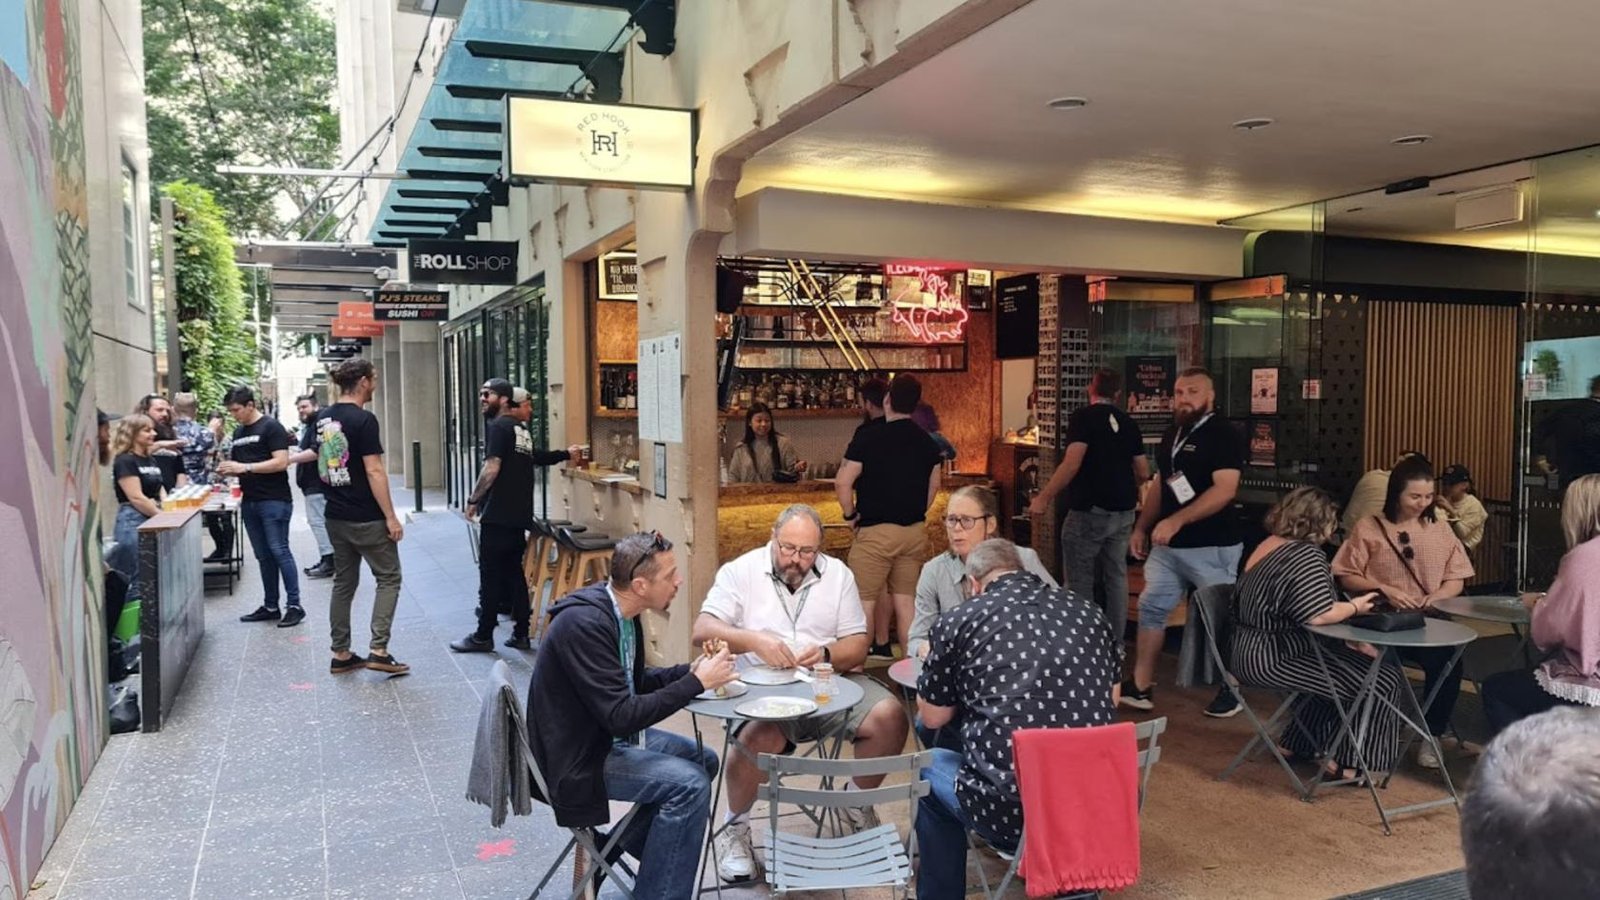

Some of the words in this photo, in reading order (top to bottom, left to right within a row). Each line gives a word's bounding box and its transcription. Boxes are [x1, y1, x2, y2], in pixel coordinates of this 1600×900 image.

[577, 112, 598, 131] RED
[602, 112, 630, 135] HOOK
[379, 294, 401, 302] PJ'S
[403, 294, 442, 302] STEAKS
[387, 310, 419, 318] SUSHI
